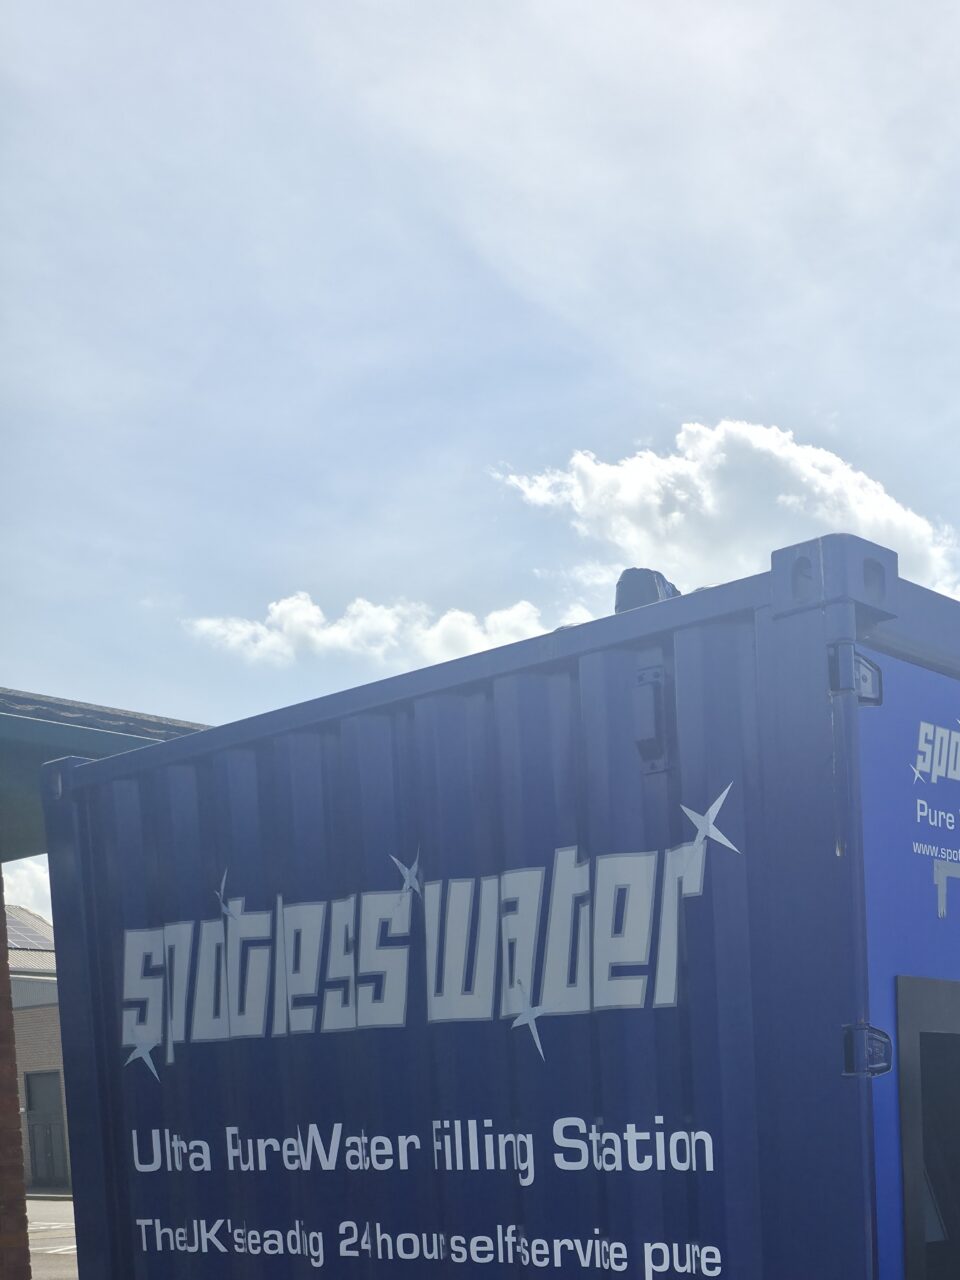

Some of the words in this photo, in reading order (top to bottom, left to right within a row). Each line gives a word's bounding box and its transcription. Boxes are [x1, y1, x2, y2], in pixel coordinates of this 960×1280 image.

[916, 798, 955, 830] Pure
[424, 840, 707, 1022] water
[432, 1119, 535, 1186] Filling
[552, 1115, 714, 1172] Station
[136, 1218, 187, 1251] The
[338, 1220, 372, 1258] 24
[376, 1222, 445, 1261] hour
[450, 1224, 628, 1271] self-service
